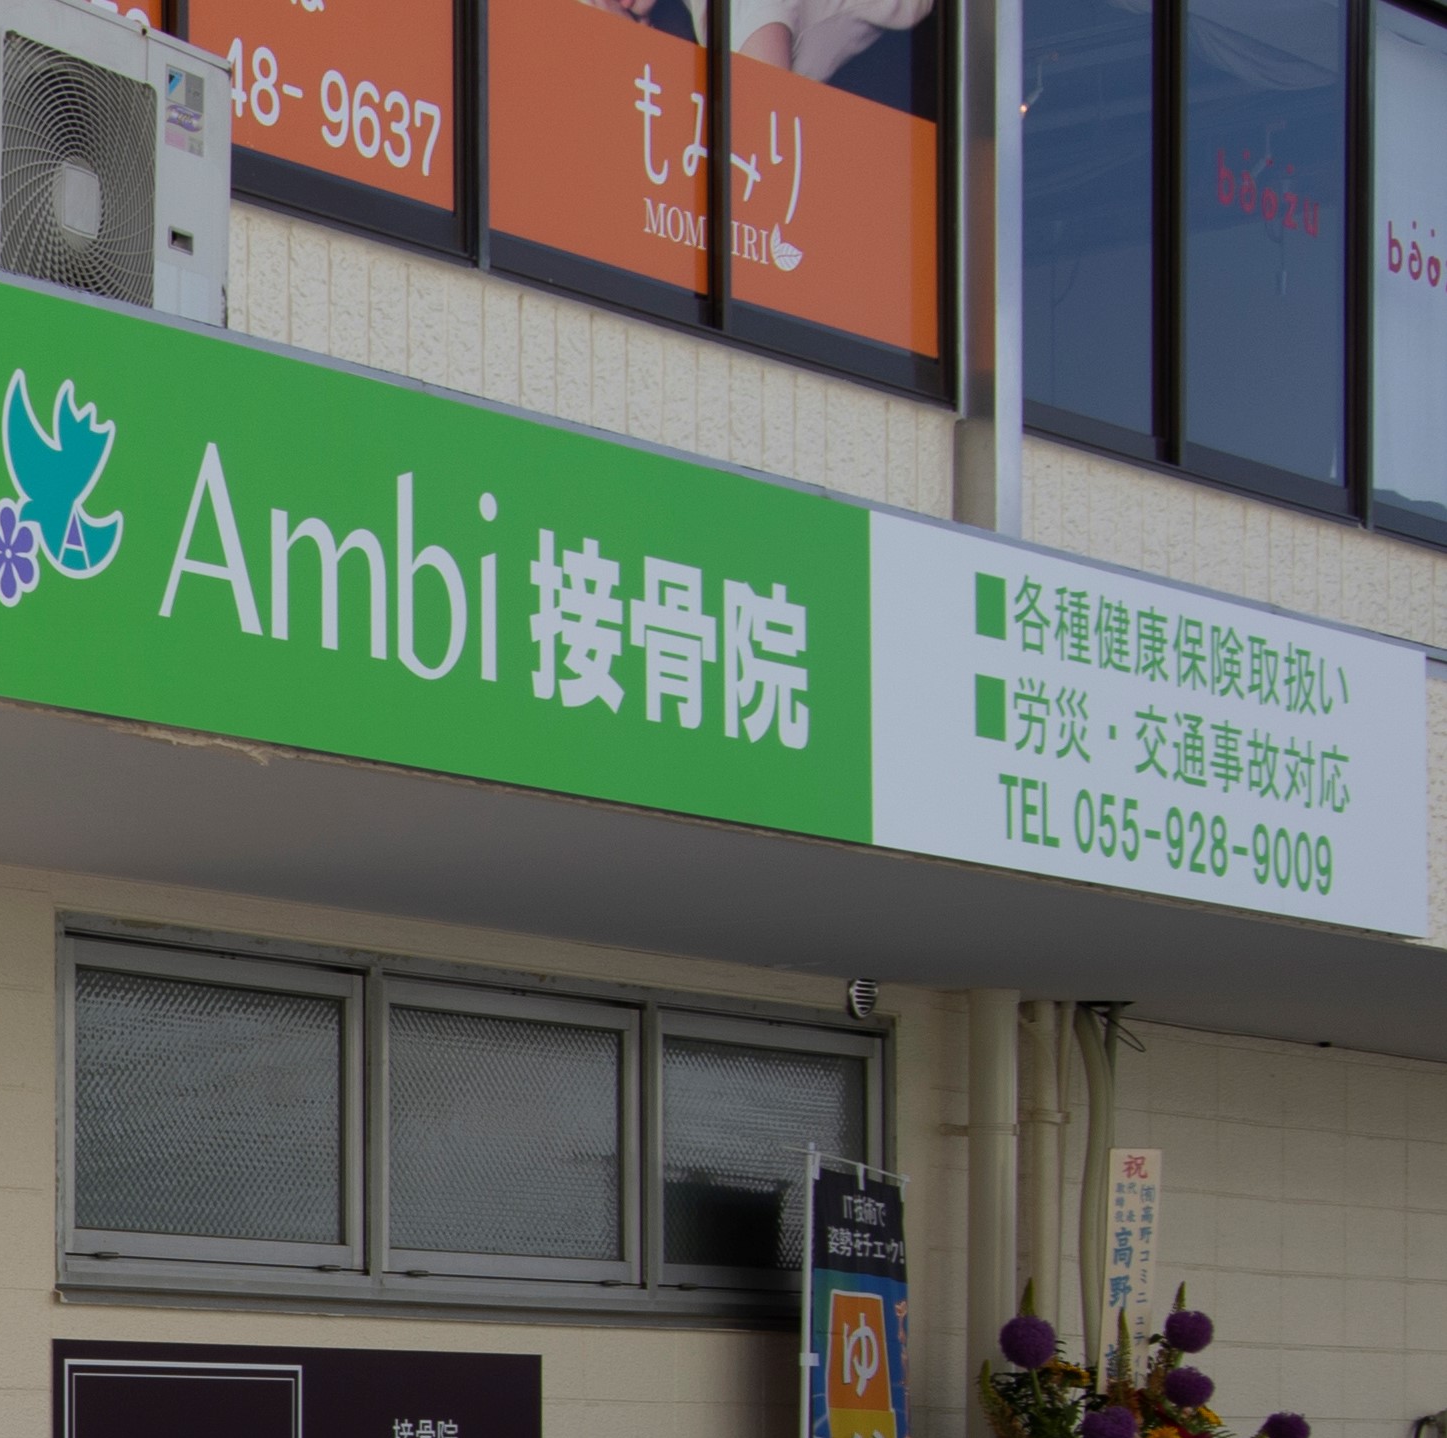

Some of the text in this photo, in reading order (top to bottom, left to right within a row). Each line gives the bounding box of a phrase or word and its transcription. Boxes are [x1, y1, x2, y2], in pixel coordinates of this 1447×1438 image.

[159, 442, 810, 749] Ambi 接骨院
[1012, 574, 1350, 717] 各種健康保険取扱い
[1012, 676, 1351, 814] 労災・交通事故対応
[998, 773, 1333, 895] TEL 055-928-9009
[1122, 1154, 1149, 1180] 祝
